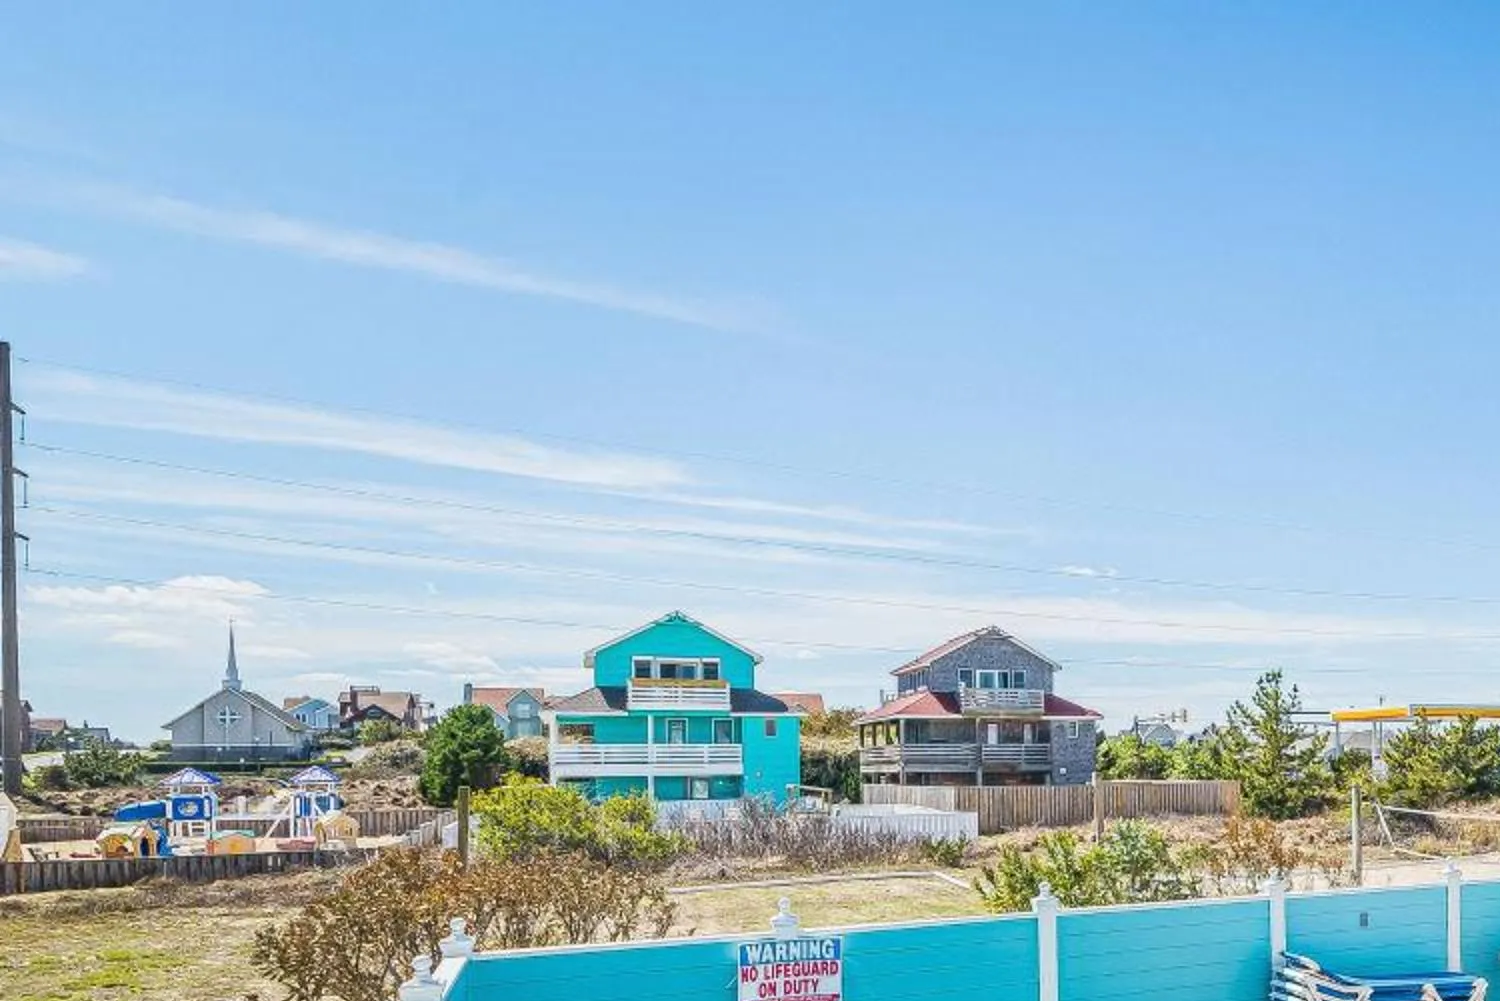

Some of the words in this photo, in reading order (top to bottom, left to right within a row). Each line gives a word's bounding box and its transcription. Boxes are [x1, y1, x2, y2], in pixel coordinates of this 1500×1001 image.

[746, 940, 834, 964] WARNING
[741, 966, 758, 982] NO
[763, 961, 839, 980] LIFEGUARD
[759, 981, 777, 998] ON
[783, 978, 819, 995] DUTY
